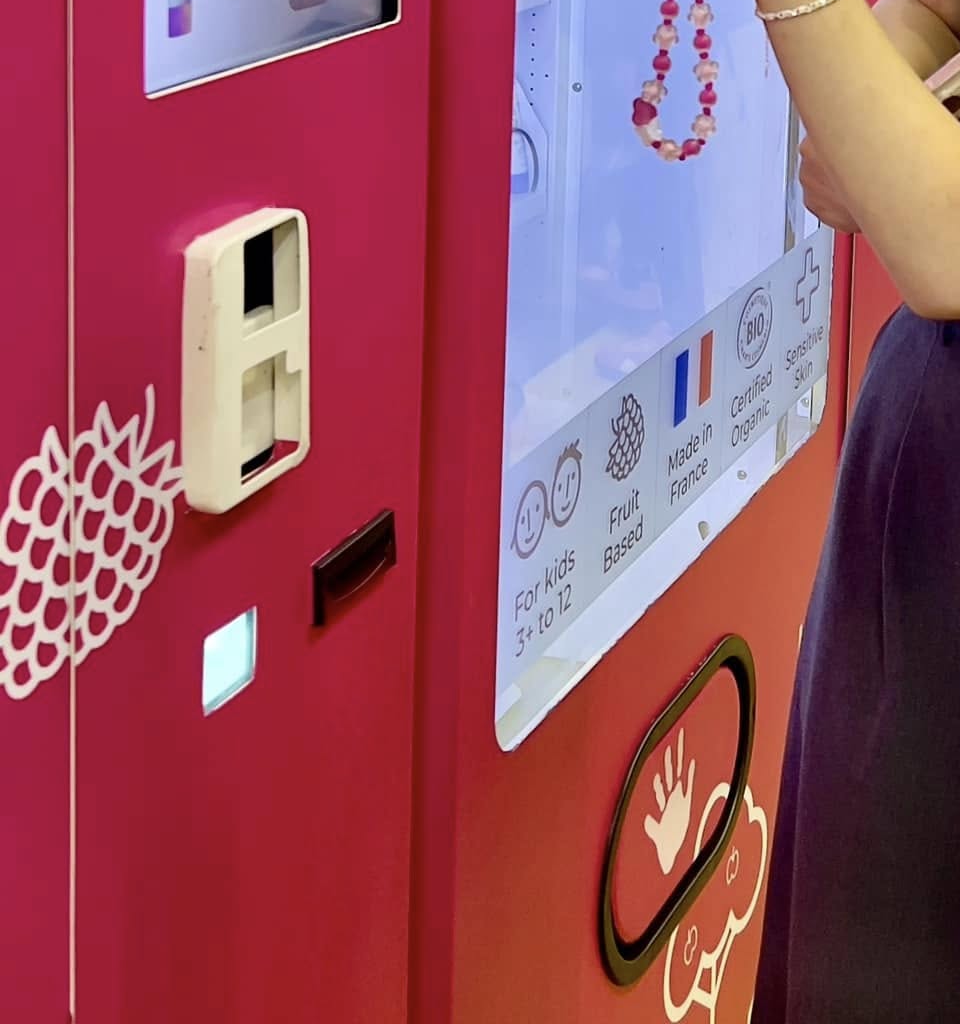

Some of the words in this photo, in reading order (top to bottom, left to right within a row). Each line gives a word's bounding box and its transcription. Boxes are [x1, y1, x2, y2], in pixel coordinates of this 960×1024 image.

[746, 312, 764, 345] BIO
[786, 326, 824, 371] Sensitive
[730, 362, 773, 419] Certified
[794, 360, 813, 390] Skin
[730, 399, 771, 448] Organic
[668, 434, 699, 476] Made
[702, 422, 713, 446] in
[670, 458, 708, 505] France
[609, 488, 640, 535] Fruit
[603, 514, 644, 574] Based
[514, 582, 541, 623] For
[544, 549, 576, 595] kids
[515, 626, 533, 658] 3+
[538, 607, 554, 636] to
[557, 583, 573, 616] 12
